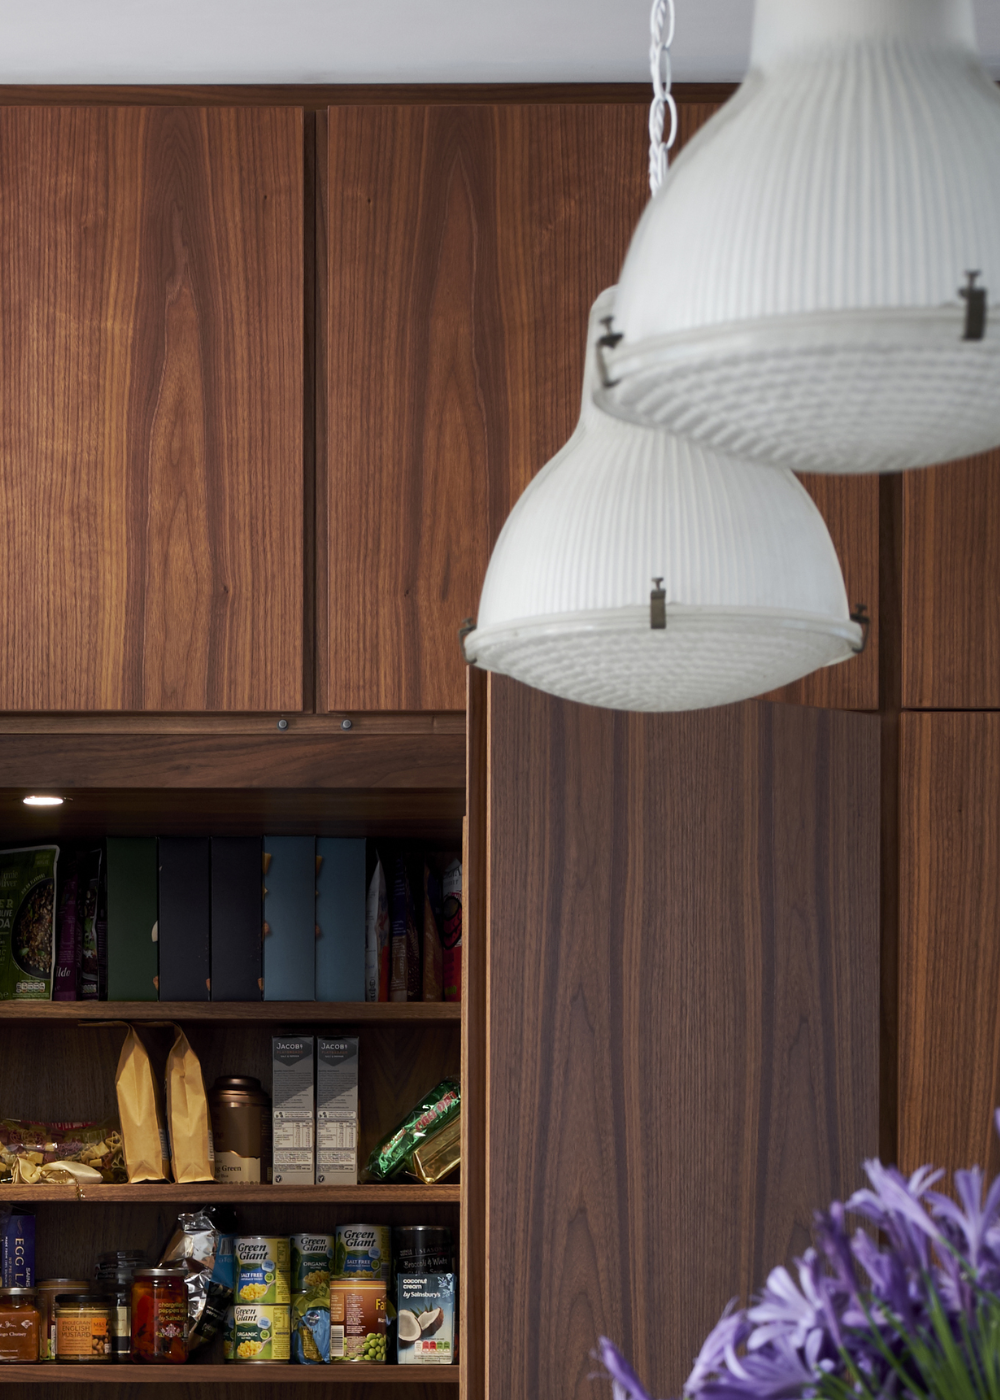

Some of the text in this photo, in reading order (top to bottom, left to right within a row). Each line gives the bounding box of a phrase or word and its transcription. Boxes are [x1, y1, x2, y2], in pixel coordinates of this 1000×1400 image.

[221, 1164, 242, 1172] Green
[344, 1229, 375, 1239] Green
[300, 1236, 326, 1245] Green
[345, 1238, 376, 1247] Giant
[237, 1242, 267, 1252] Green
[302, 1244, 328, 1252] Giant
[14, 1238, 25, 1266] EGG
[239, 1251, 269, 1260] Giant
[402, 1291, 411, 1299] by
[235, 1307, 257, 1315] Green
